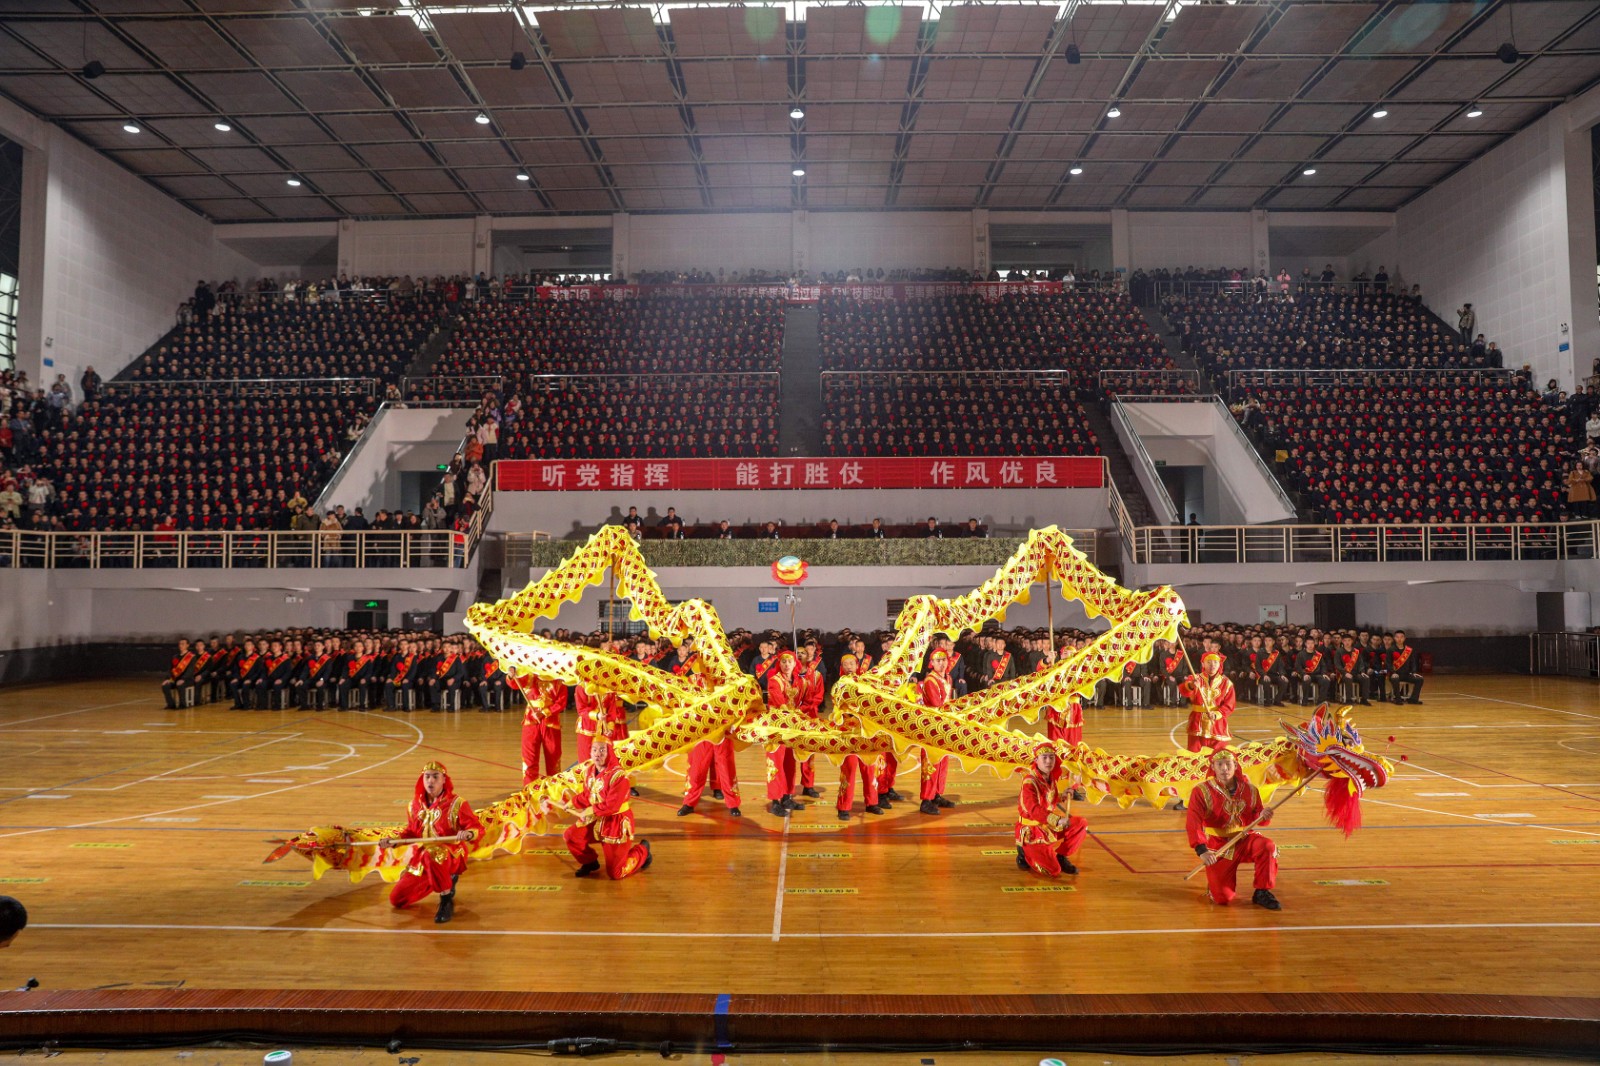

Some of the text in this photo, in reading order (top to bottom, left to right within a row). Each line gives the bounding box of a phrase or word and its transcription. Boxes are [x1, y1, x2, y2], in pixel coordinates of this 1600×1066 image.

[542, 461, 1059, 487] 听党指挥 能打胜仗 作风优良
